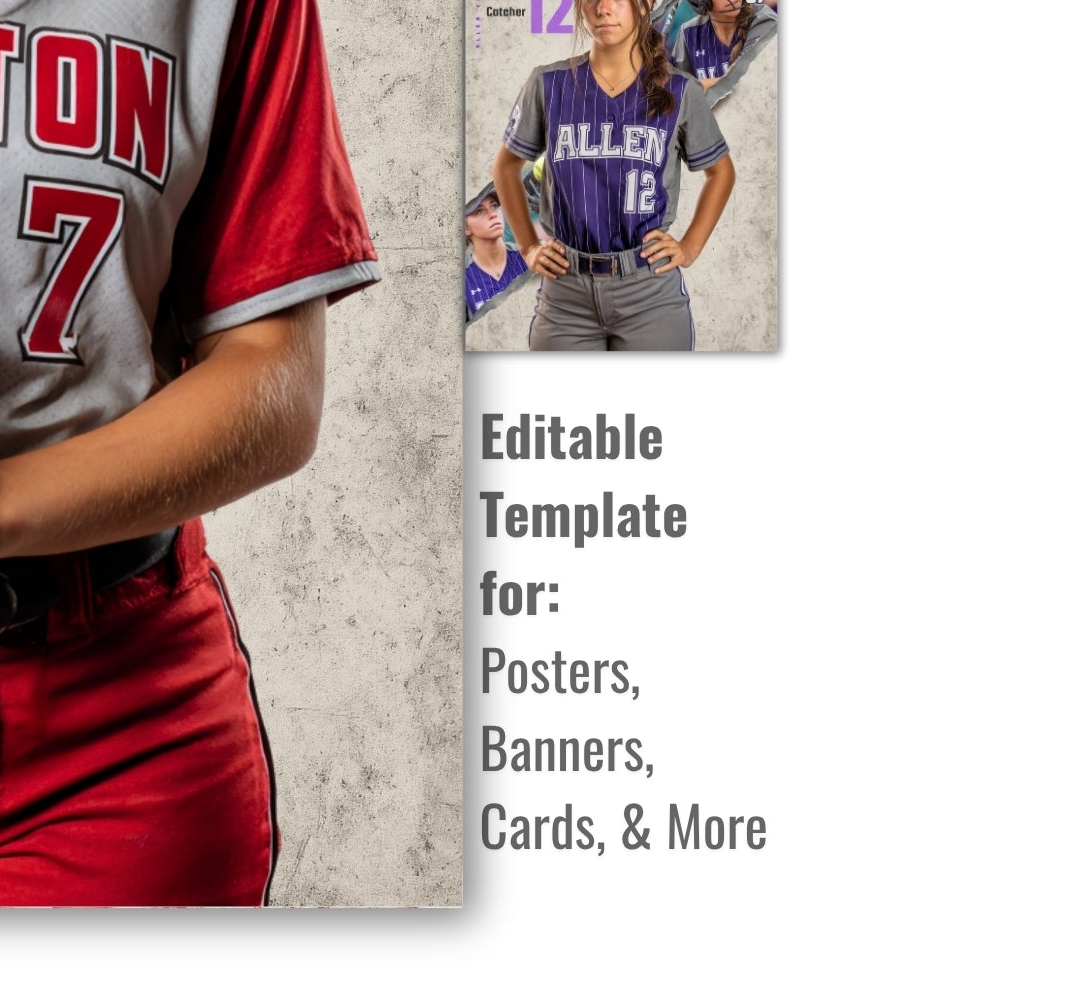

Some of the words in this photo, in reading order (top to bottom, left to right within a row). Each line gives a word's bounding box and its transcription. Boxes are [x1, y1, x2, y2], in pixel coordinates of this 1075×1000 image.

[486, 6, 526, 17] Catcher
[554, 122, 667, 167] ALLEN
[623, 168, 657, 214] 12
[17, 174, 132, 366] 7
